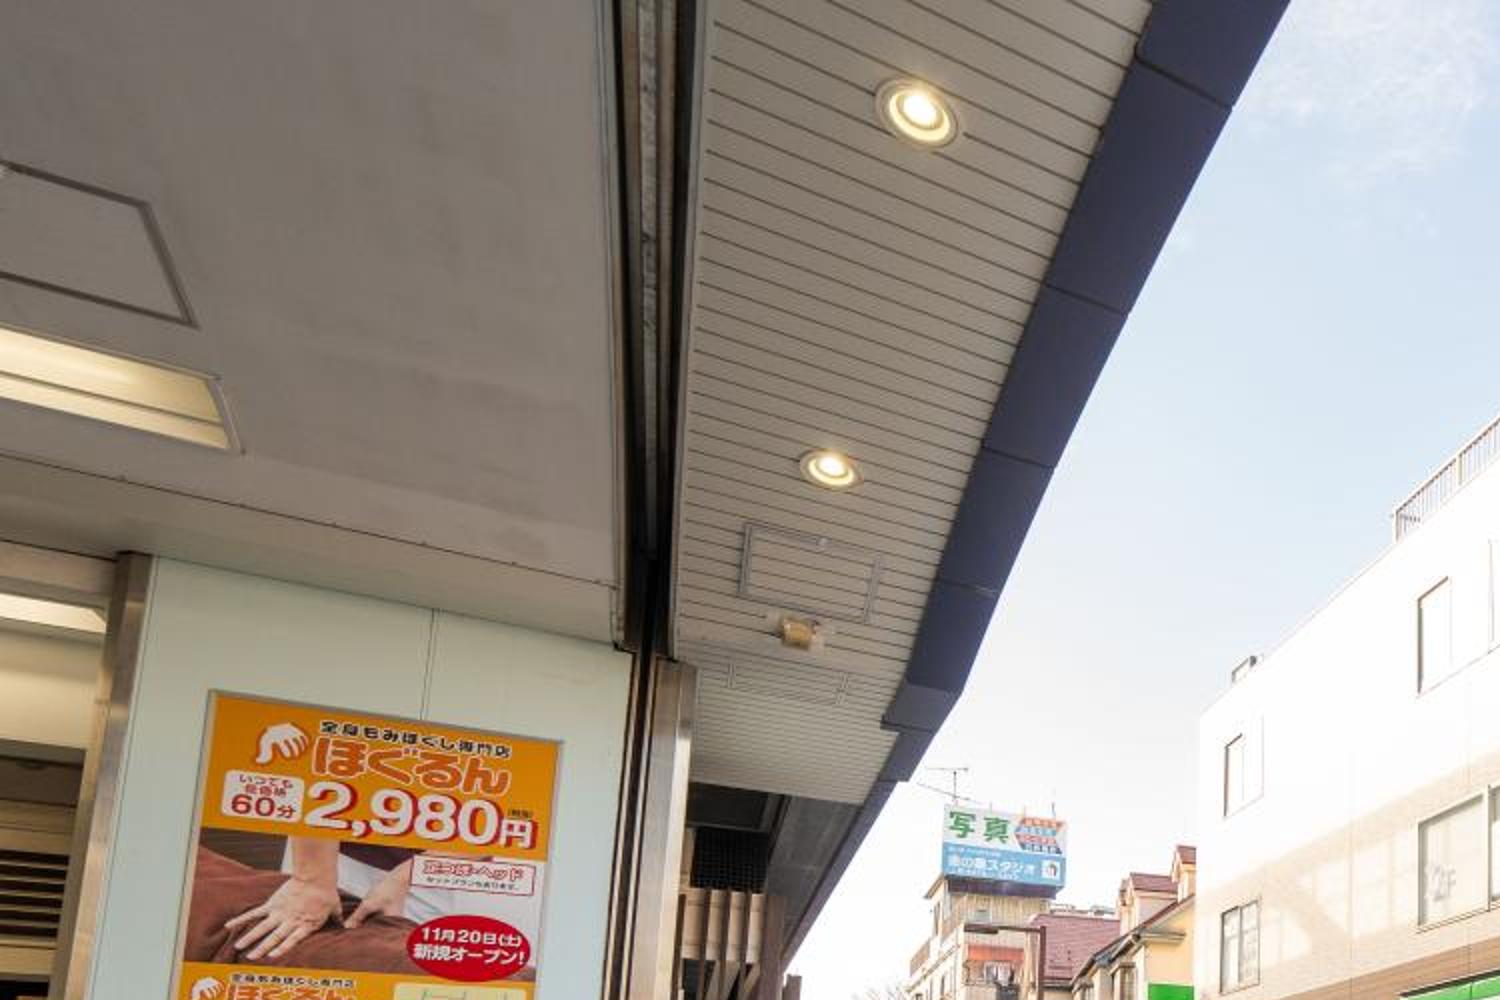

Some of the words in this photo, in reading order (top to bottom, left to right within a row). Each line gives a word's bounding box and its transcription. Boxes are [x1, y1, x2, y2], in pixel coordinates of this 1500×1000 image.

[312, 736, 511, 796] ほぐるん
[231, 794, 296, 819] 60分
[304, 780, 537, 849] 2,980円
[949, 810, 1010, 843] 写真
